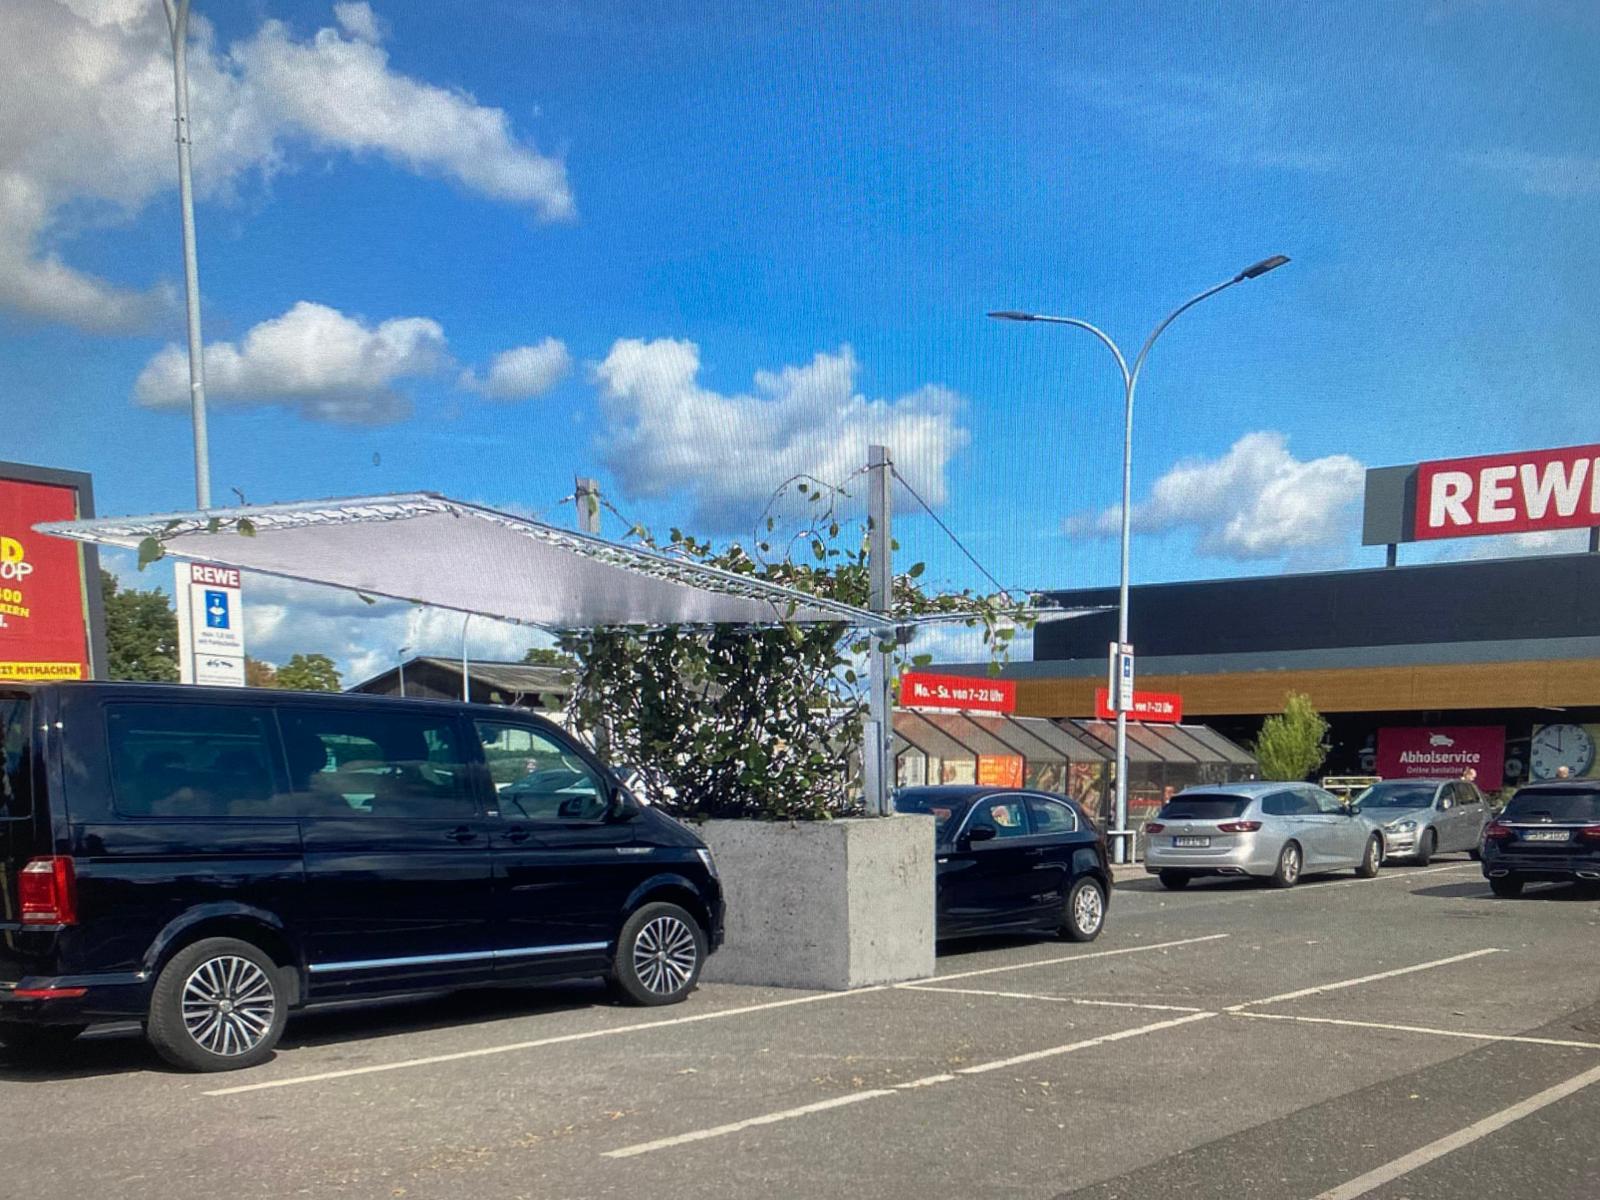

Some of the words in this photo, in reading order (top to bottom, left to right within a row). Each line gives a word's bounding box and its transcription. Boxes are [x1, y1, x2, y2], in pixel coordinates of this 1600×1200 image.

[1429, 456, 1600, 528] REW
[192, 565, 239, 587] REWE
[952, 689, 968, 700] von
[989, 688, 1004, 703] Uhr
[1400, 750, 1480, 763] Abholservice
